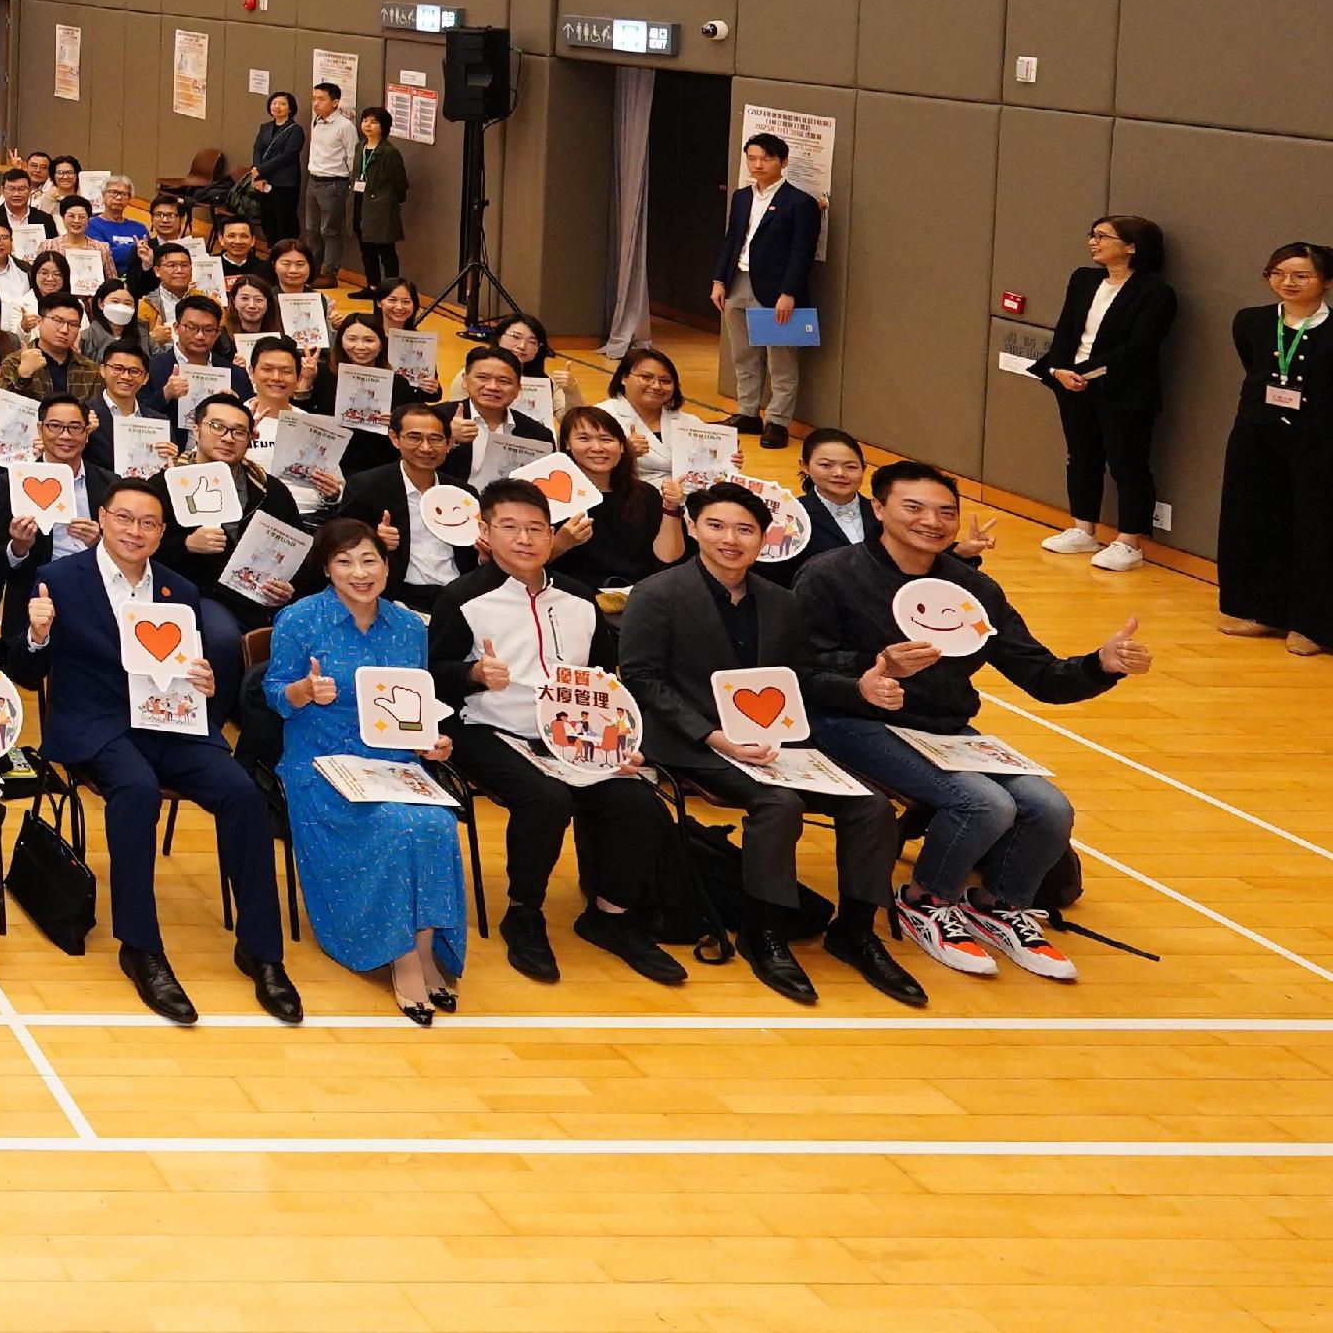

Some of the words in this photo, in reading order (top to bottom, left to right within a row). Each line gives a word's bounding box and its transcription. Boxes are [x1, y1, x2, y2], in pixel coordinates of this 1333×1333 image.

[556, 666, 590, 686] 優質
[538, 684, 610, 709] 大廈管理
